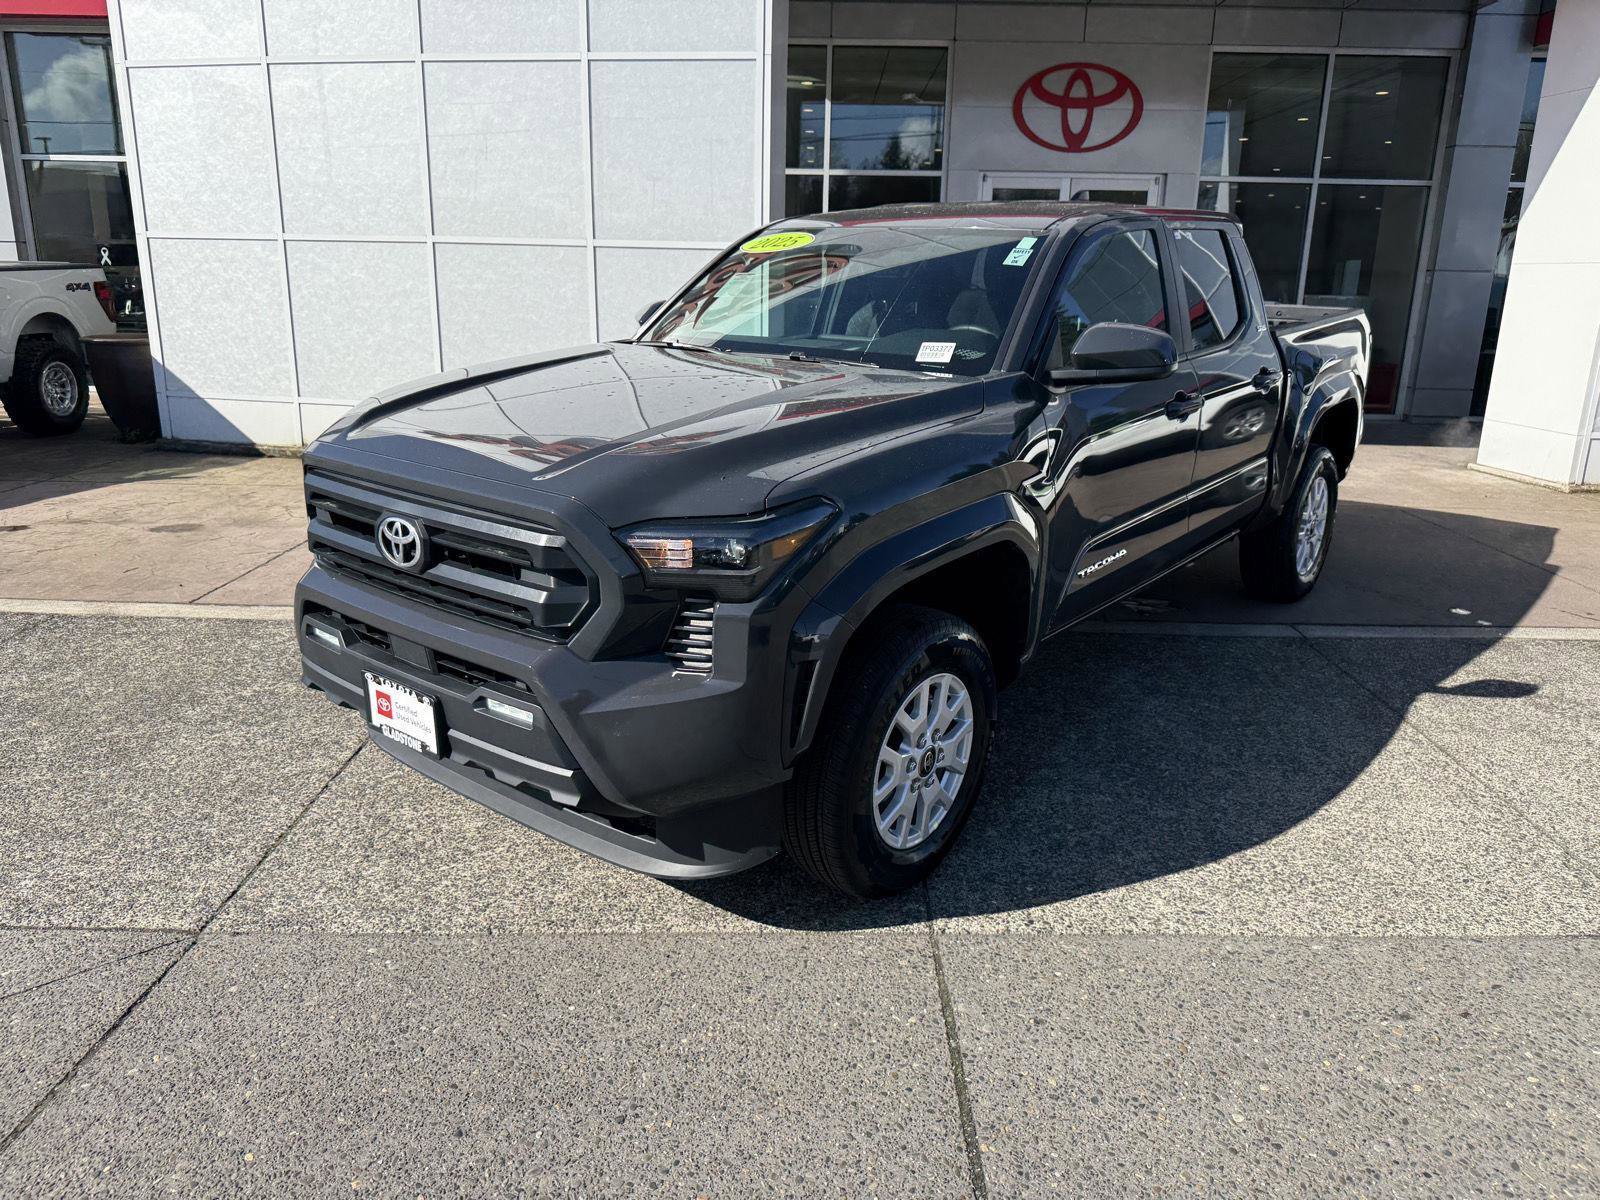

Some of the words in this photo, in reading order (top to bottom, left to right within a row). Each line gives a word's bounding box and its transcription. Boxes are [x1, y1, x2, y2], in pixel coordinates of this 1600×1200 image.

[748, 236, 807, 249] 2025
[1077, 548, 1128, 579] TACOMA
[395, 702, 418, 718] Certified
[410, 717, 432, 735] Vehicles
[381, 724, 423, 753] GLADSTONE
